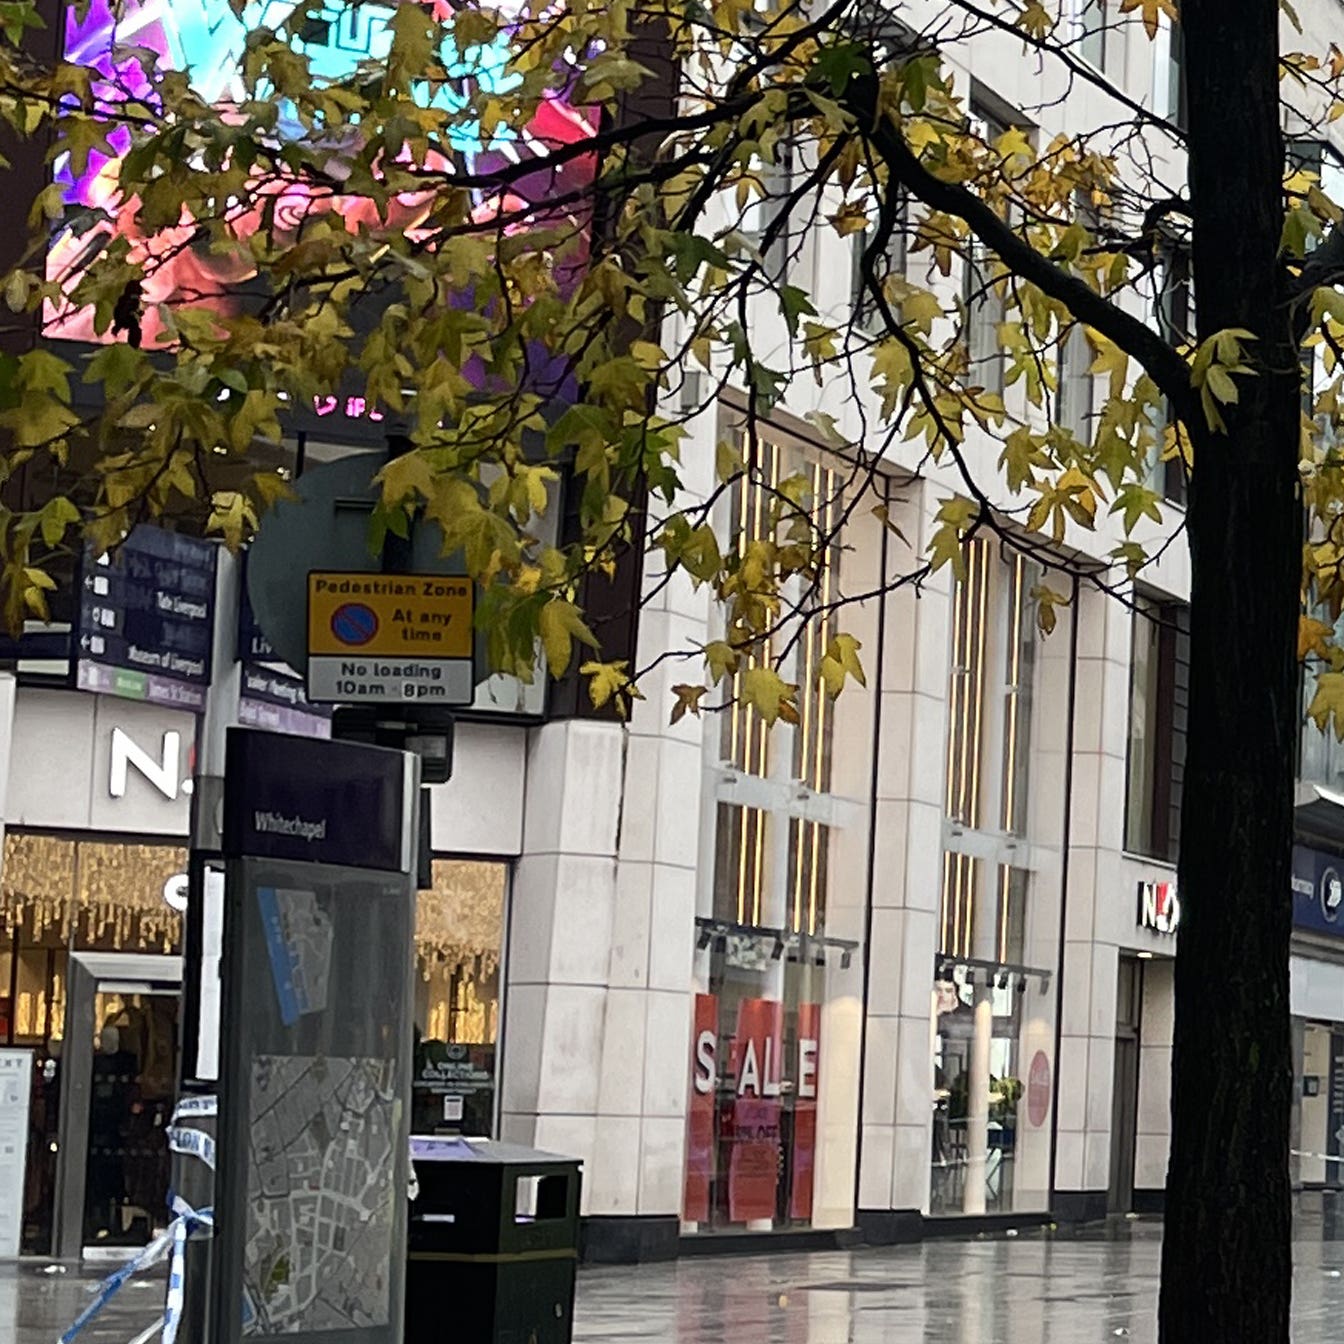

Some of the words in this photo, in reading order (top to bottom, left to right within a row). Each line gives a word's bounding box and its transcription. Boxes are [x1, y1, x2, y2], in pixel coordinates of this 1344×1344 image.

[315, 579, 416, 595] Pedestrian
[423, 582, 467, 597] Zone
[392, 609, 412, 623] At
[420, 612, 452, 627] any
[402, 628, 443, 642] time
[341, 662, 367, 677] No
[374, 663, 442, 680] loading
[336, 680, 385, 695] 10am
[404, 683, 446, 698] 8pm
[254, 810, 327, 843] Whitechapel
[695, 1030, 818, 1097] SALE
